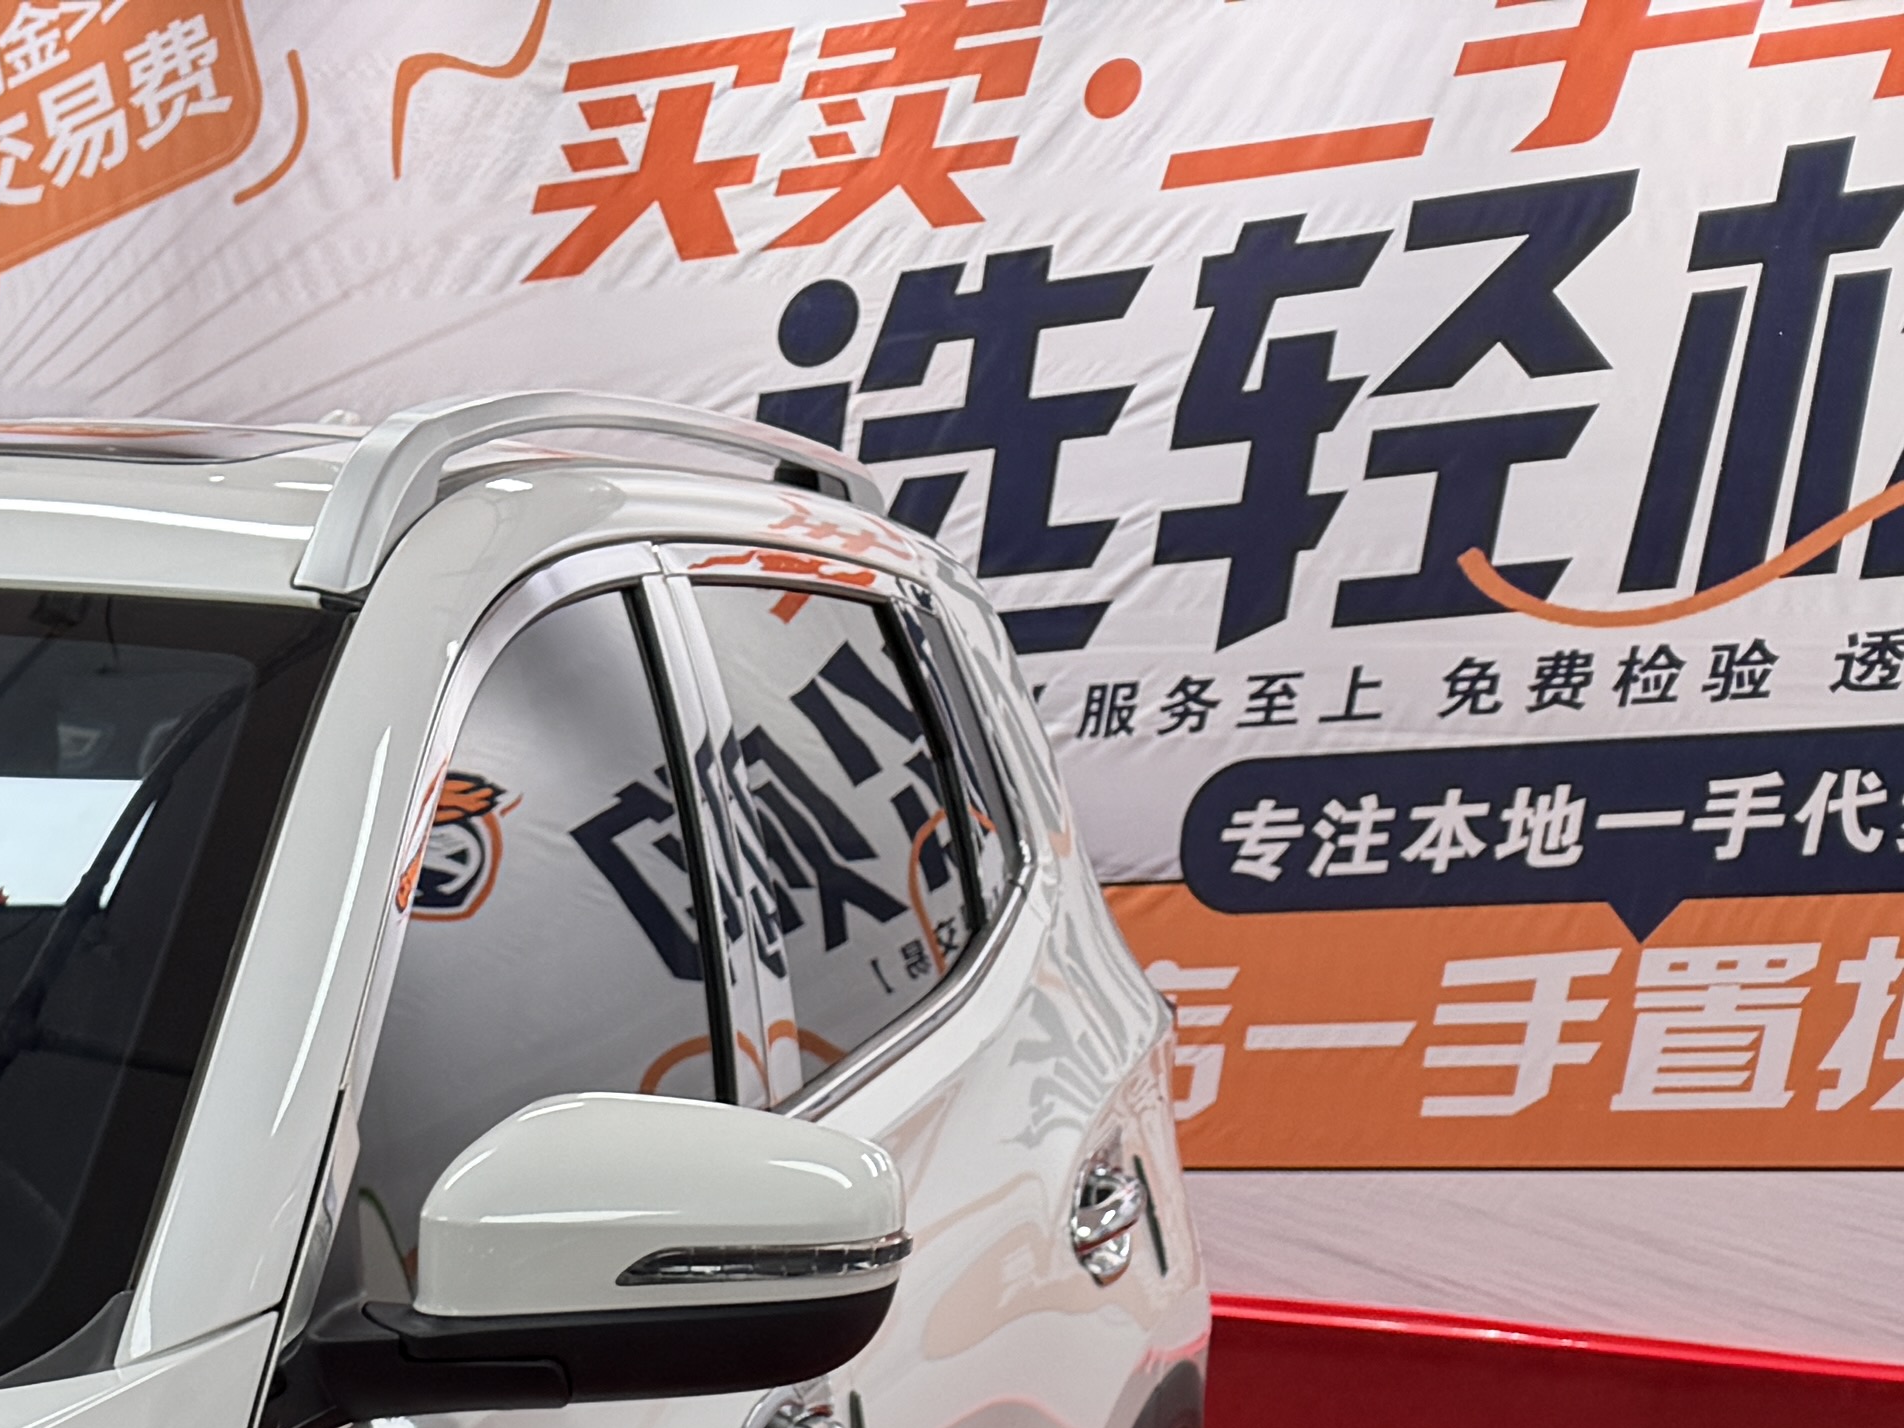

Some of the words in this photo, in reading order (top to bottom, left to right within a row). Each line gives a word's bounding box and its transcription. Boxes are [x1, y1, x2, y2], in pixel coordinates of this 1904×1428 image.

[1076, 672, 1384, 740] 服务至上
[1438, 638, 1780, 720] 免费检验
[1220, 769, 1904, 882] 专注本地一手代
